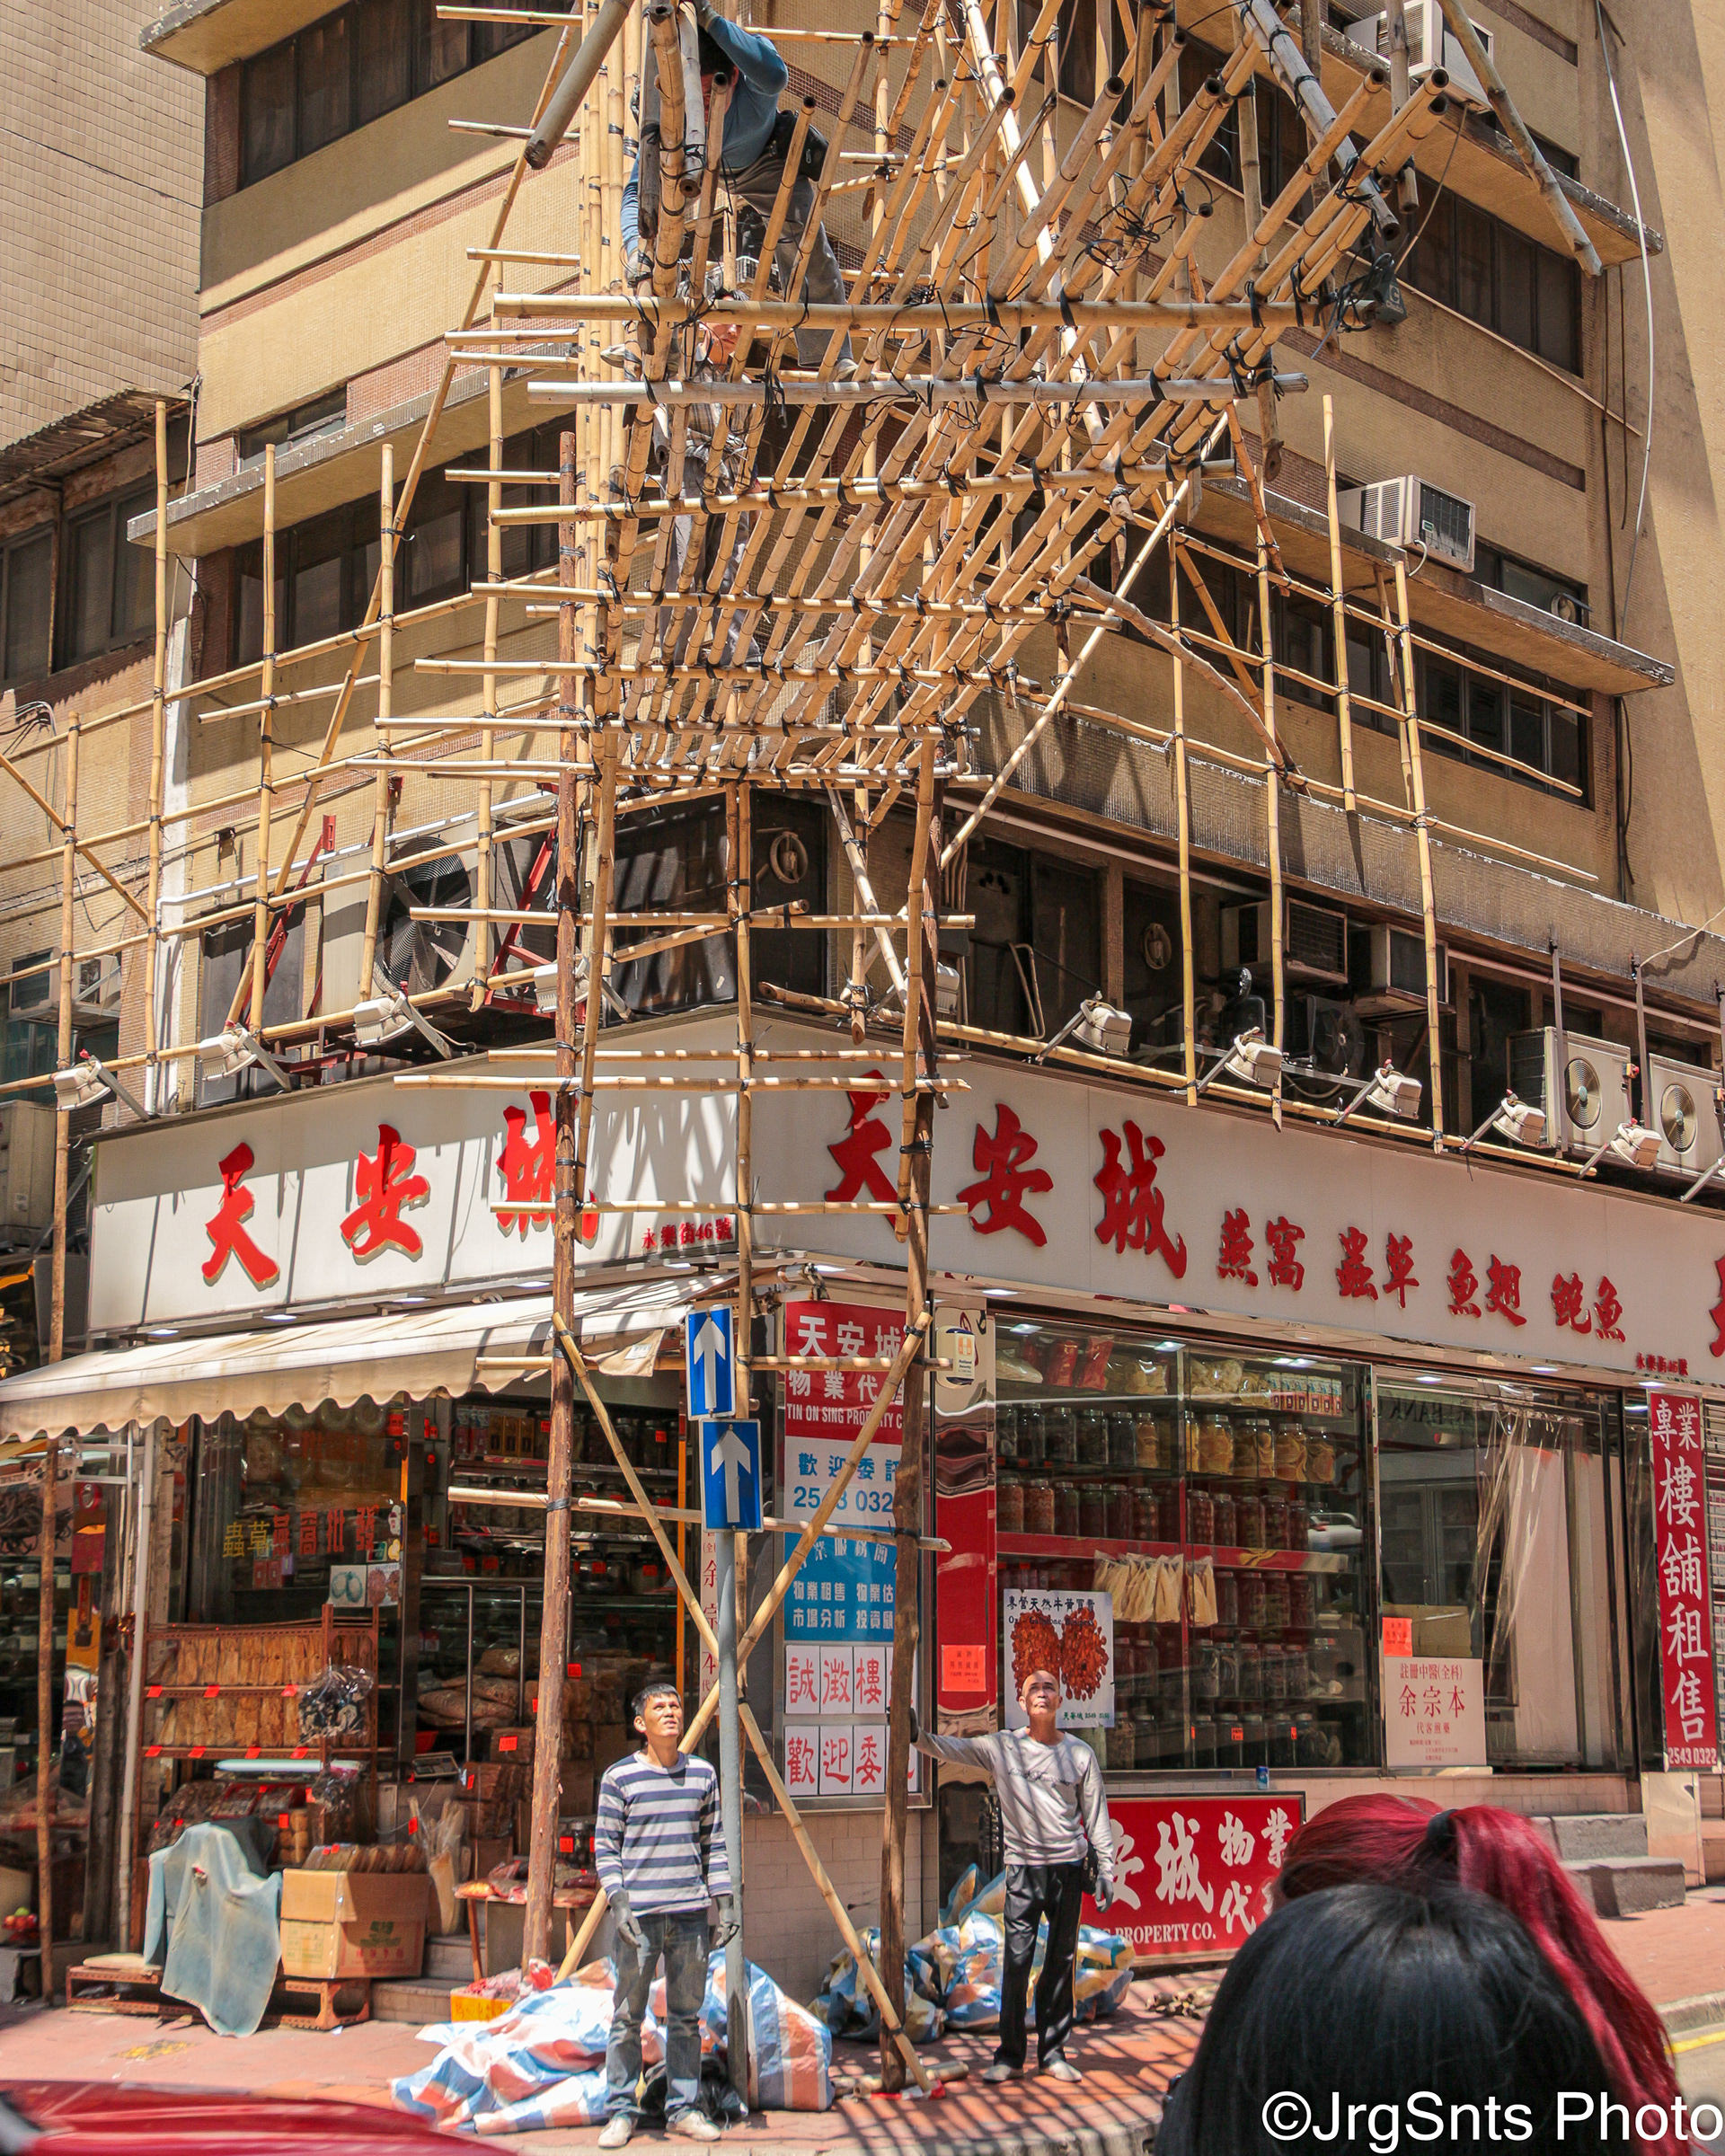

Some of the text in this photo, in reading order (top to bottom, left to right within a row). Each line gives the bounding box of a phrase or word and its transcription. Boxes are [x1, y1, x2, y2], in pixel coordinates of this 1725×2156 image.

[824, 1069, 1188, 1279] 天安城
[1216, 1207, 1305, 1292] 燕窩
[1336, 1225, 1420, 1309] 蟲草
[1446, 1248, 1527, 1327] 魚翅
[1551, 1272, 1626, 1343] 鮑魚
[787, 1403, 802, 1420] TIN
[806, 1404, 818, 1422] ON
[822, 1406, 844, 1424] SING
[896, 1413, 903, 1429] C
[1653, 1399, 1699, 1452] 專業
[793, 1486, 894, 1514] 253 032
[793, 1607, 845, 1628] 市場分析
[1659, 1455, 1709, 1744] 樓舖租售
[789, 1657, 913, 1705] 誠徵樓
[1399, 1683, 1465, 1719] 余宗本
[787, 1735, 915, 1786] 歡迎委
[1668, 1746, 1717, 1766] 2543 0322
[1191, 1922, 1216, 1941] CO.
[1220, 1880, 1273, 1936] 代
